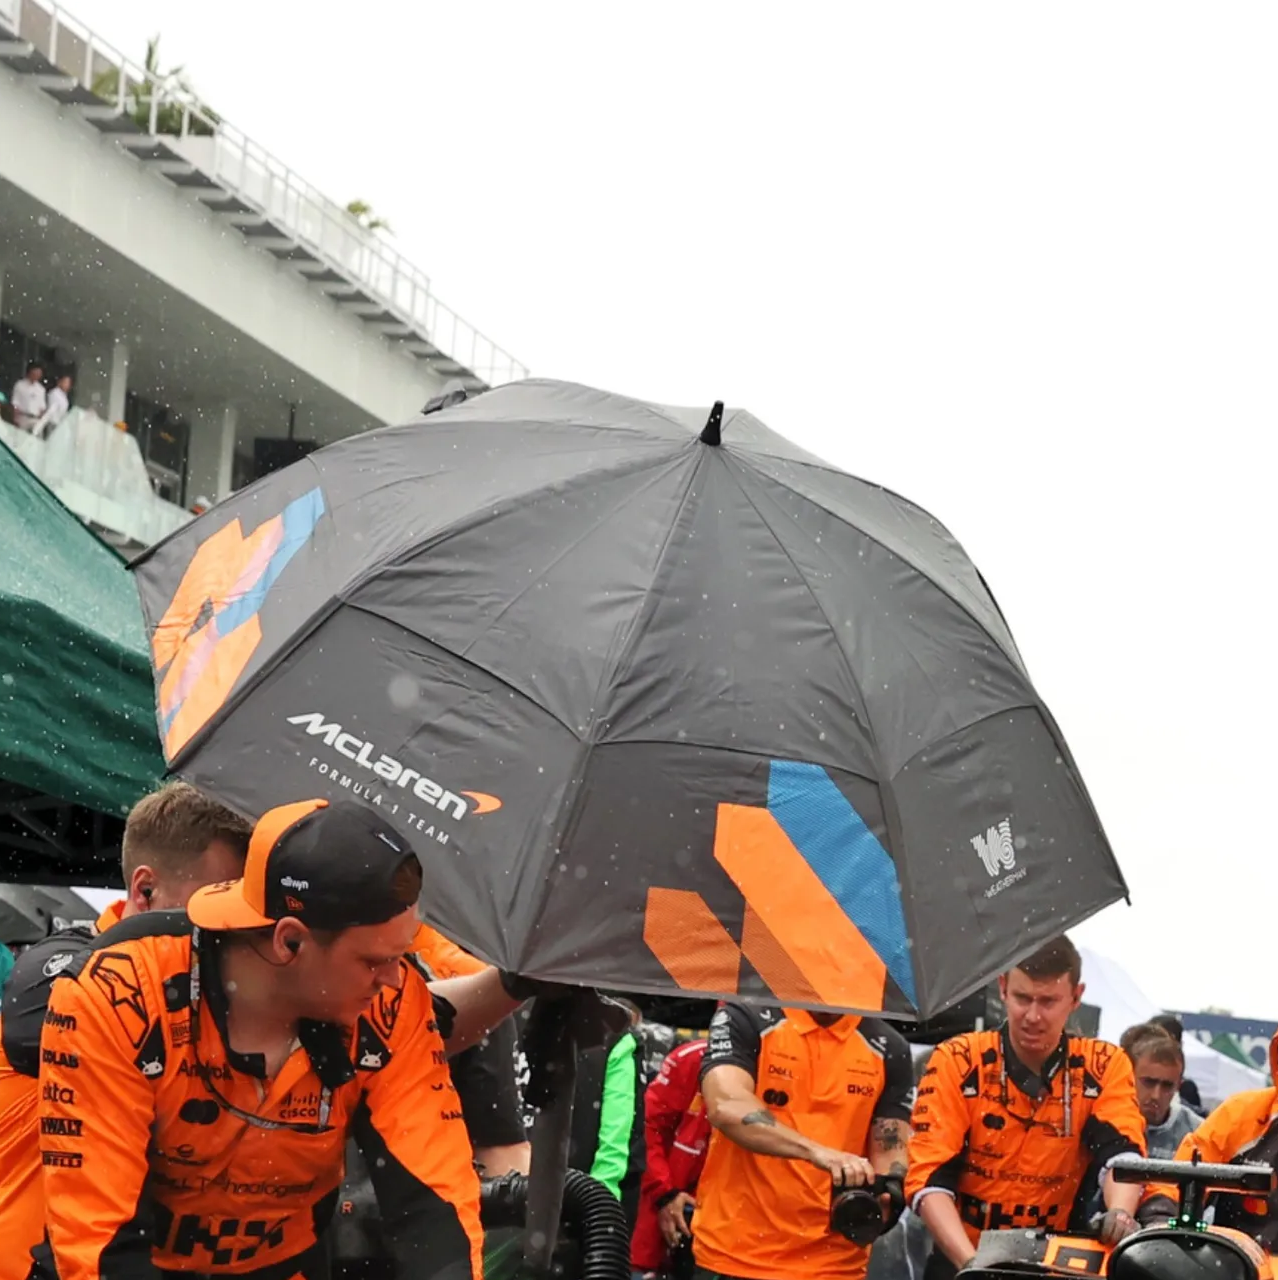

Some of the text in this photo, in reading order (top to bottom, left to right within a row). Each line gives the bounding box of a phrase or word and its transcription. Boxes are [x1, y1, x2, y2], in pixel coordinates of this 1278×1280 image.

[286, 711, 469, 821] McLaren
[308, 756, 383, 806] FORMULA
[390, 803, 400, 815] 1
[407, 813, 451, 845] TEAM
